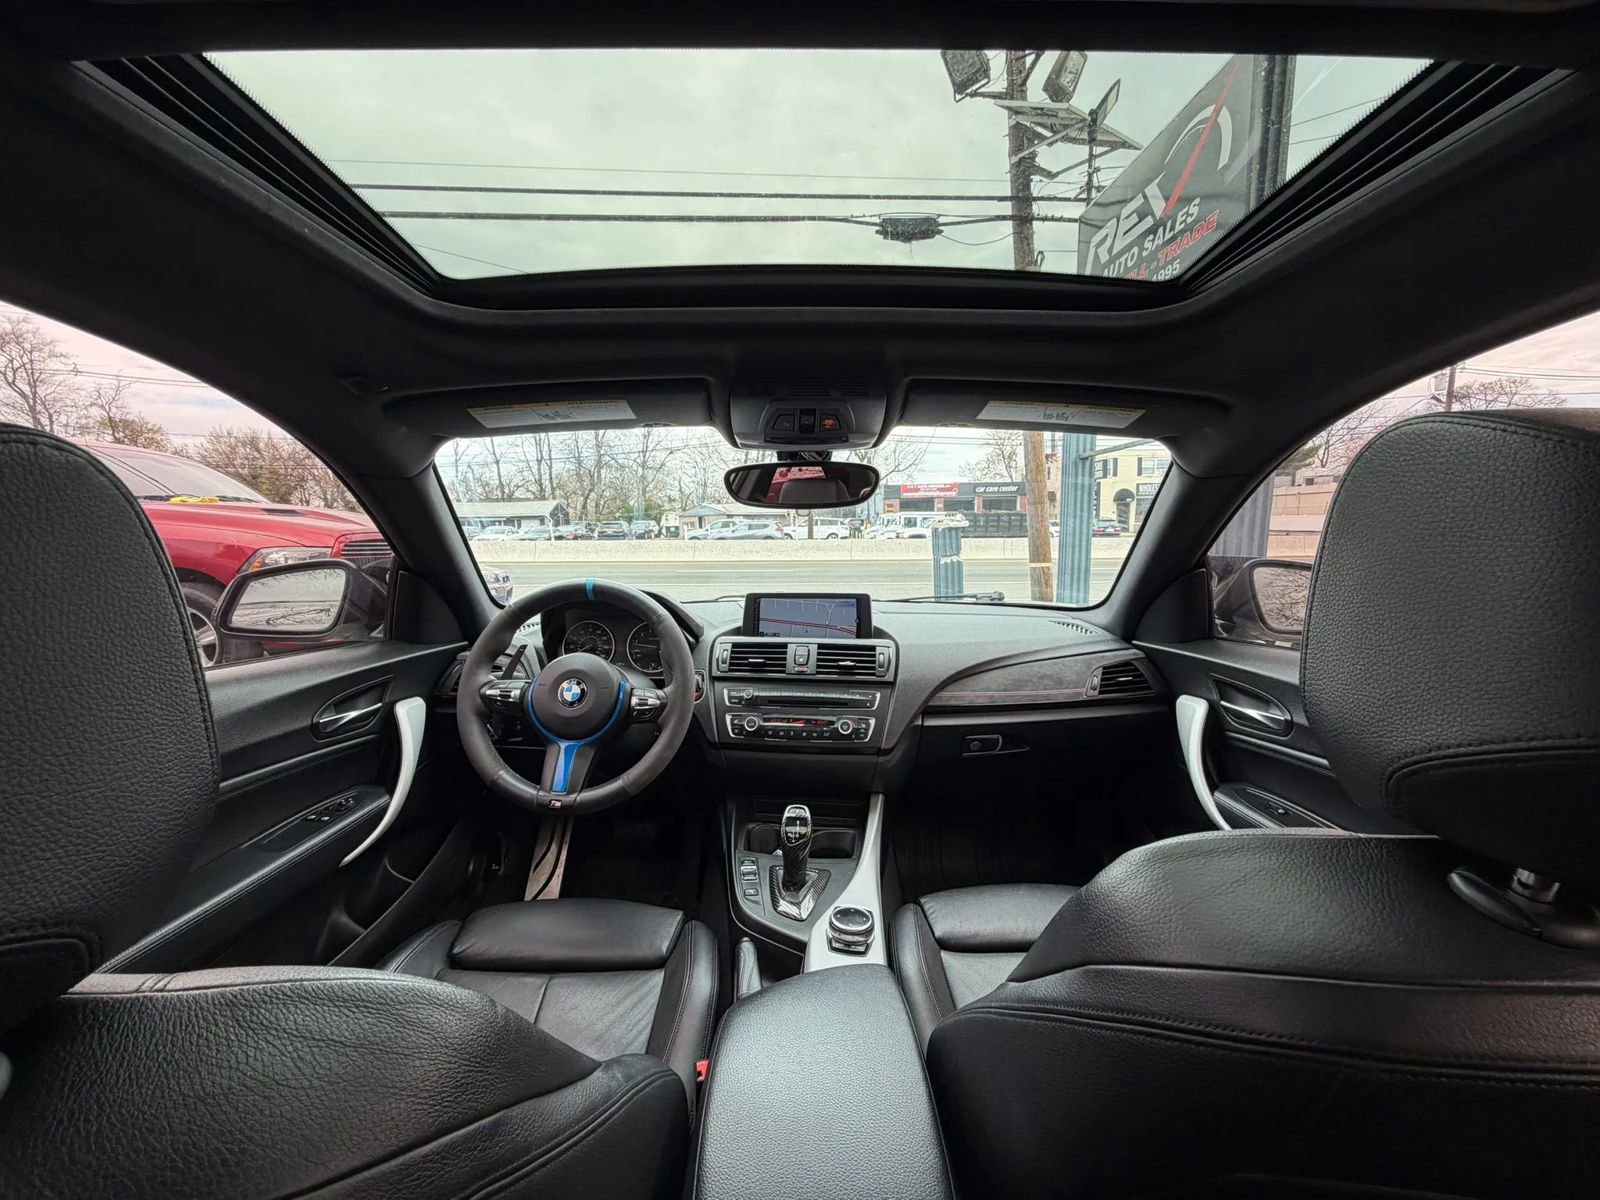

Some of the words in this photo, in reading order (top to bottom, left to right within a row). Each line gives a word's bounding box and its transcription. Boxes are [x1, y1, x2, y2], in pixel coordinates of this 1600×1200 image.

[1142, 197, 1201, 257] SALES
[1157, 209, 1219, 266] TRADE
[986, 485, 999, 493] care
[999, 484, 1019, 492] center
